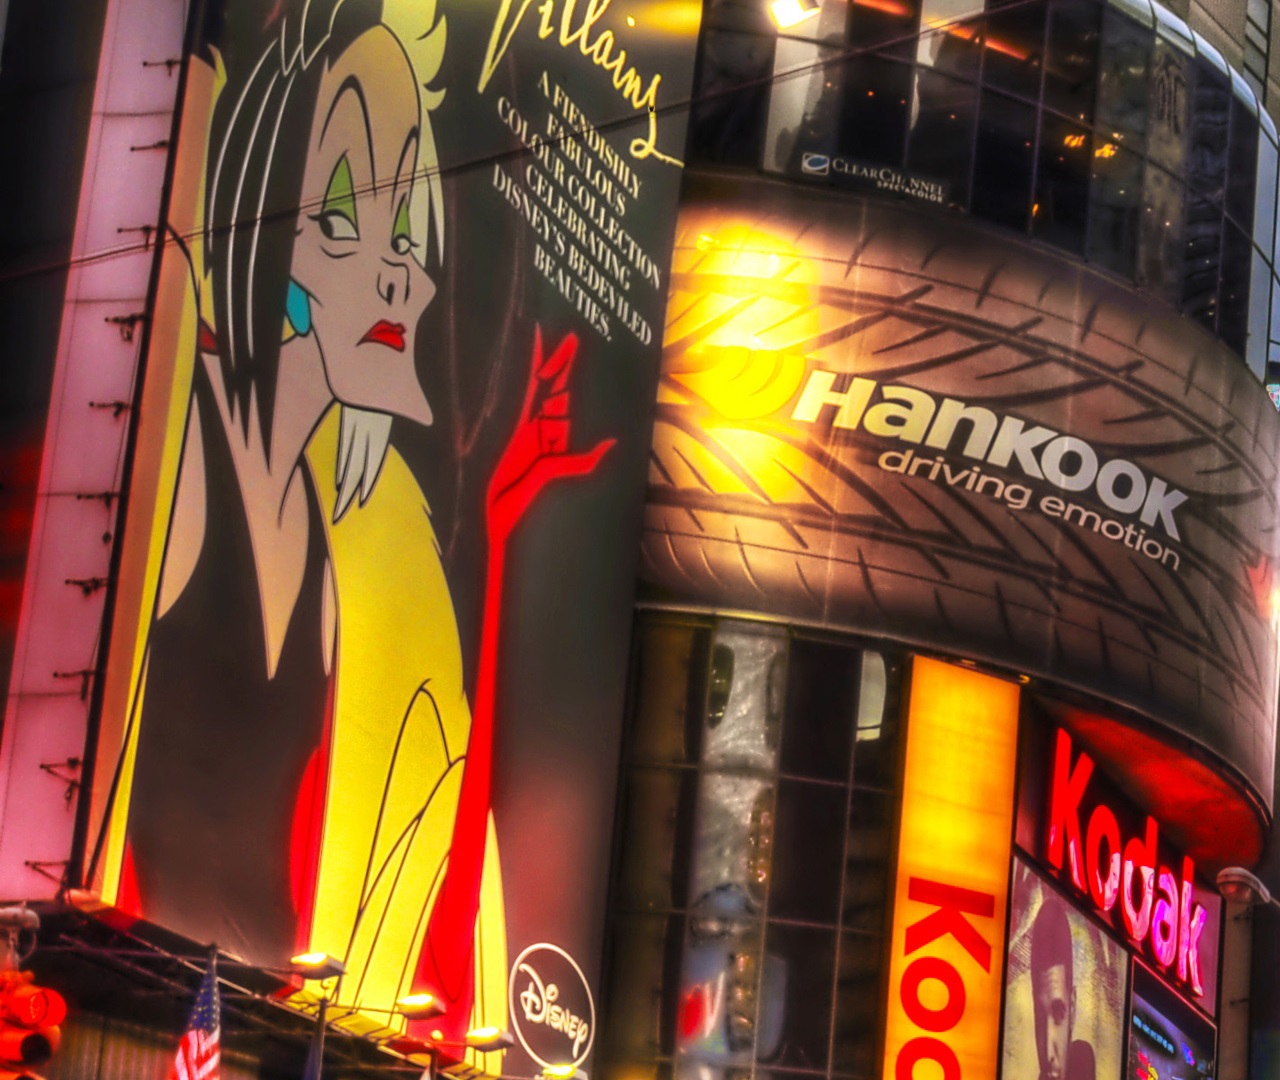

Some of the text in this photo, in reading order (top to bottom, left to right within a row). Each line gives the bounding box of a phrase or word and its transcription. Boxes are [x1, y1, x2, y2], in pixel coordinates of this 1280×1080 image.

[497, 96, 661, 289] COLOUR COLLECTION
[537, 70, 642, 199] A FIENDISHLY
[547, 113, 626, 216] FABULOUS
[492, 163, 652, 346] DISNEY'S BEDEVILED
[526, 164, 630, 290] CELEBRATING
[534, 243, 613, 342] BEAUTIES.
[877, 445, 1184, 565] driving emotion
[1048, 727, 1208, 998] Kodak
[519, 963, 589, 1059] Disney
